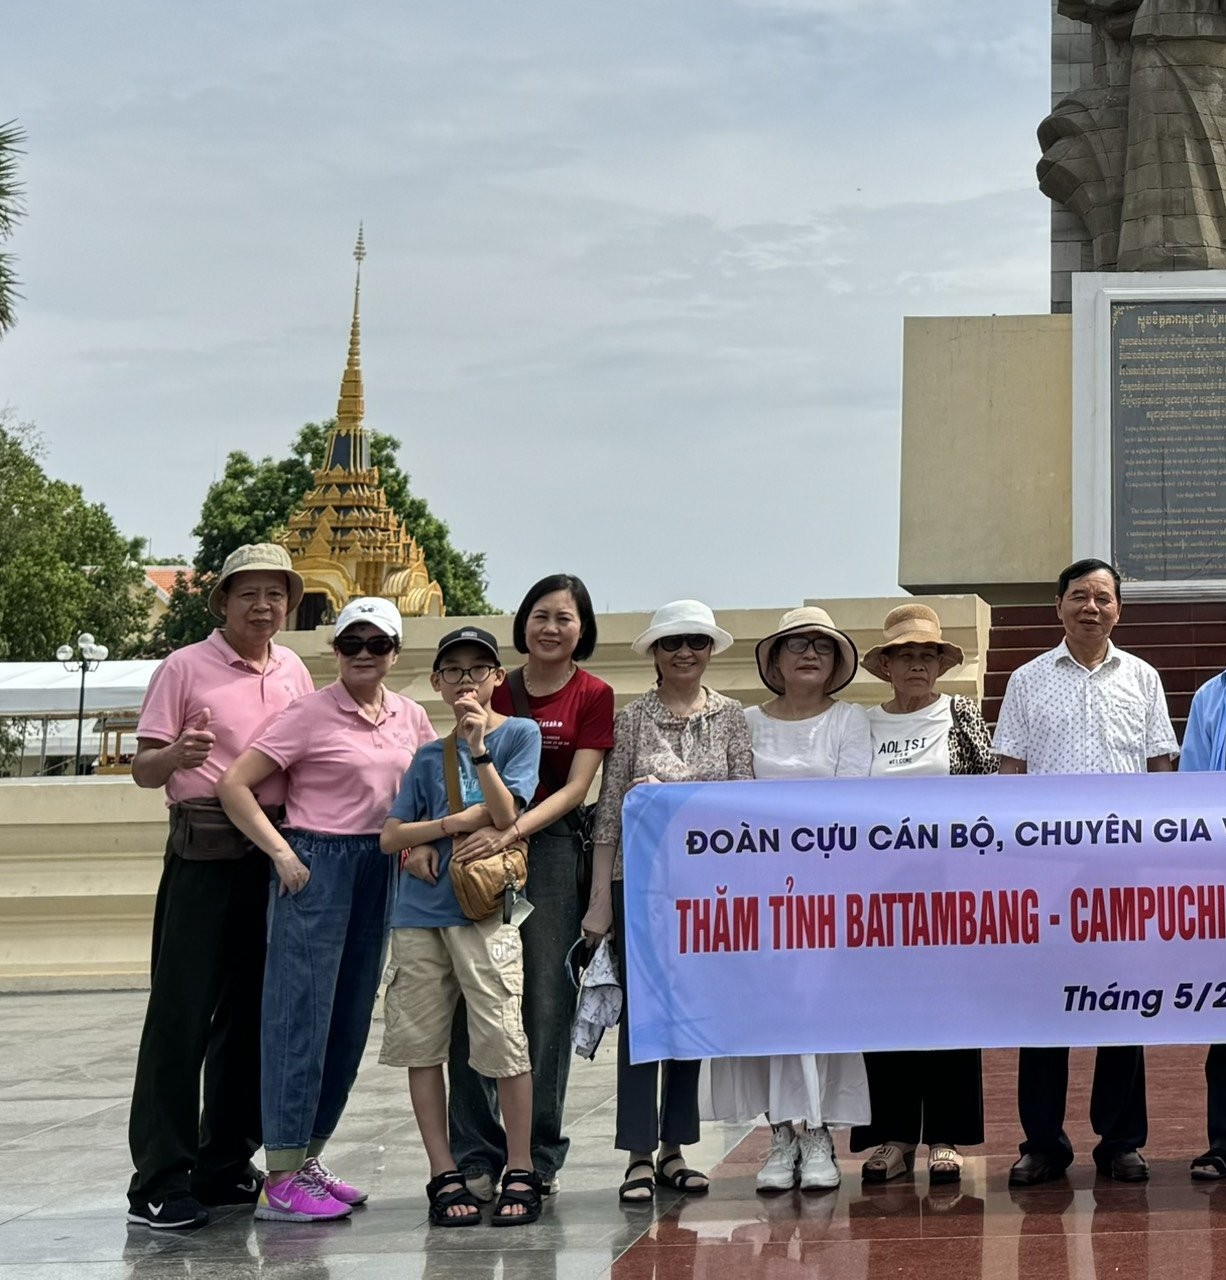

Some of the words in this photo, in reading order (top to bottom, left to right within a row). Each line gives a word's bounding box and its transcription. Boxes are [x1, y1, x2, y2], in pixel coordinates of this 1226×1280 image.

[878, 737, 927, 755] AOLISI
[686, 822, 780, 855] ĐOÀN
[791, 825, 858, 859] CỰU
[868, 818, 938, 851] CÁN
[950, 816, 1004, 856] BỘ,
[1014, 813, 1143, 847] CHUYÊN
[1153, 818, 1212, 843] GIA
[676, 884, 760, 954] THĂM
[769, 876, 836, 951] TỈNH
[846, 888, 1040, 949] BATTAMBANG
[1049, 914, 1061, 926] -
[1063, 981, 1164, 1018] Tháng
